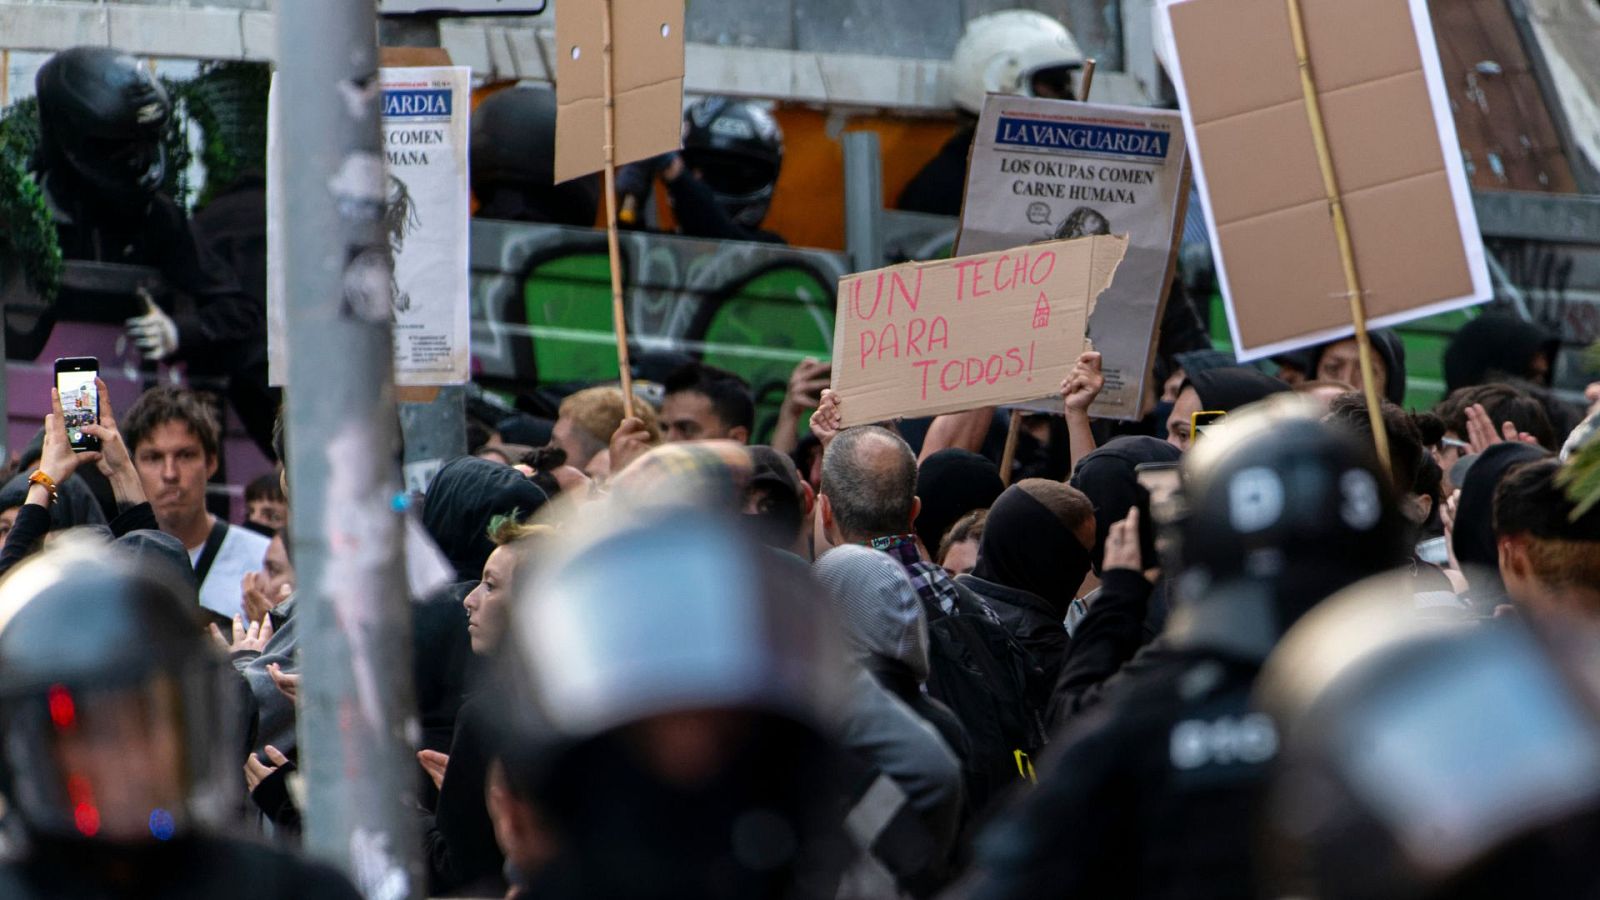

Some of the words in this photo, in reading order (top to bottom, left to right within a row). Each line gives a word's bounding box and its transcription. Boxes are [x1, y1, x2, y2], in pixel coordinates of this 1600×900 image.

[382, 94, 447, 114] UARDIA
[389, 130, 443, 145] COMEN
[1002, 123, 1029, 142] LA
[1031, 127, 1162, 154] VANGUARDIA
[386, 150, 429, 166] MANA
[1000, 158, 1030, 174] LOS
[1034, 160, 1095, 181] OKUPAS
[1098, 166, 1154, 185] COMEN
[1012, 180, 1066, 199] CARNE
[1068, 185, 1136, 204] HUMANA
[953, 251, 1056, 301] TECHO
[860, 315, 948, 369] PARA
[912, 340, 1035, 400] TODOS!
